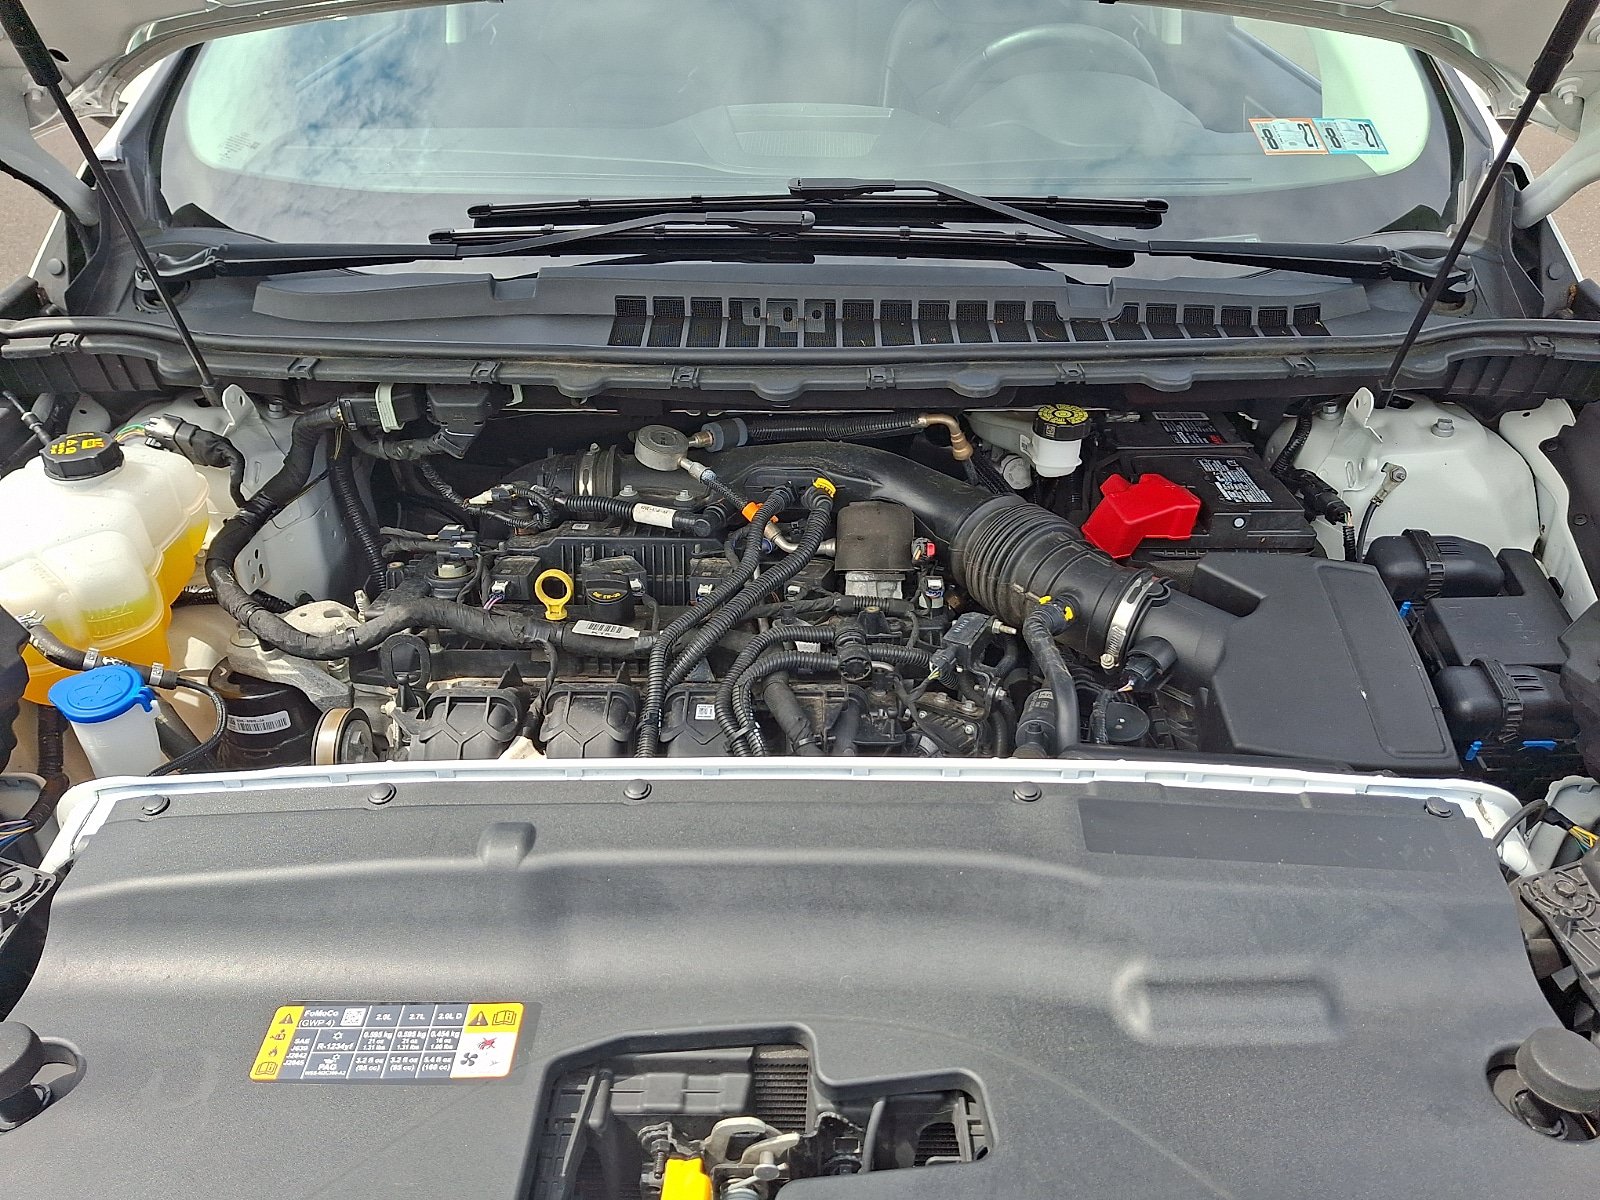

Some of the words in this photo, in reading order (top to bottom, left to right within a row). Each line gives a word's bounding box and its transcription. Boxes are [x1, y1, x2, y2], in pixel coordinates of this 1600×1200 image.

[1261, 128, 1279, 150] 8
[1297, 123, 1320, 149] 27
[1325, 127, 1342, 149] 8
[1357, 123, 1380, 149] 27
[304, 1009, 339, 1017] FoMoCo
[298, 1020, 324, 1028] (GWP
[325, 1019, 336, 1028] 4)
[383, 1031, 393, 1039] kg
[417, 1030, 427, 1039] kg
[450, 1030, 460, 1039] kg
[317, 1042, 354, 1051] R-1234yf
[317, 1063, 337, 1071] PAG
